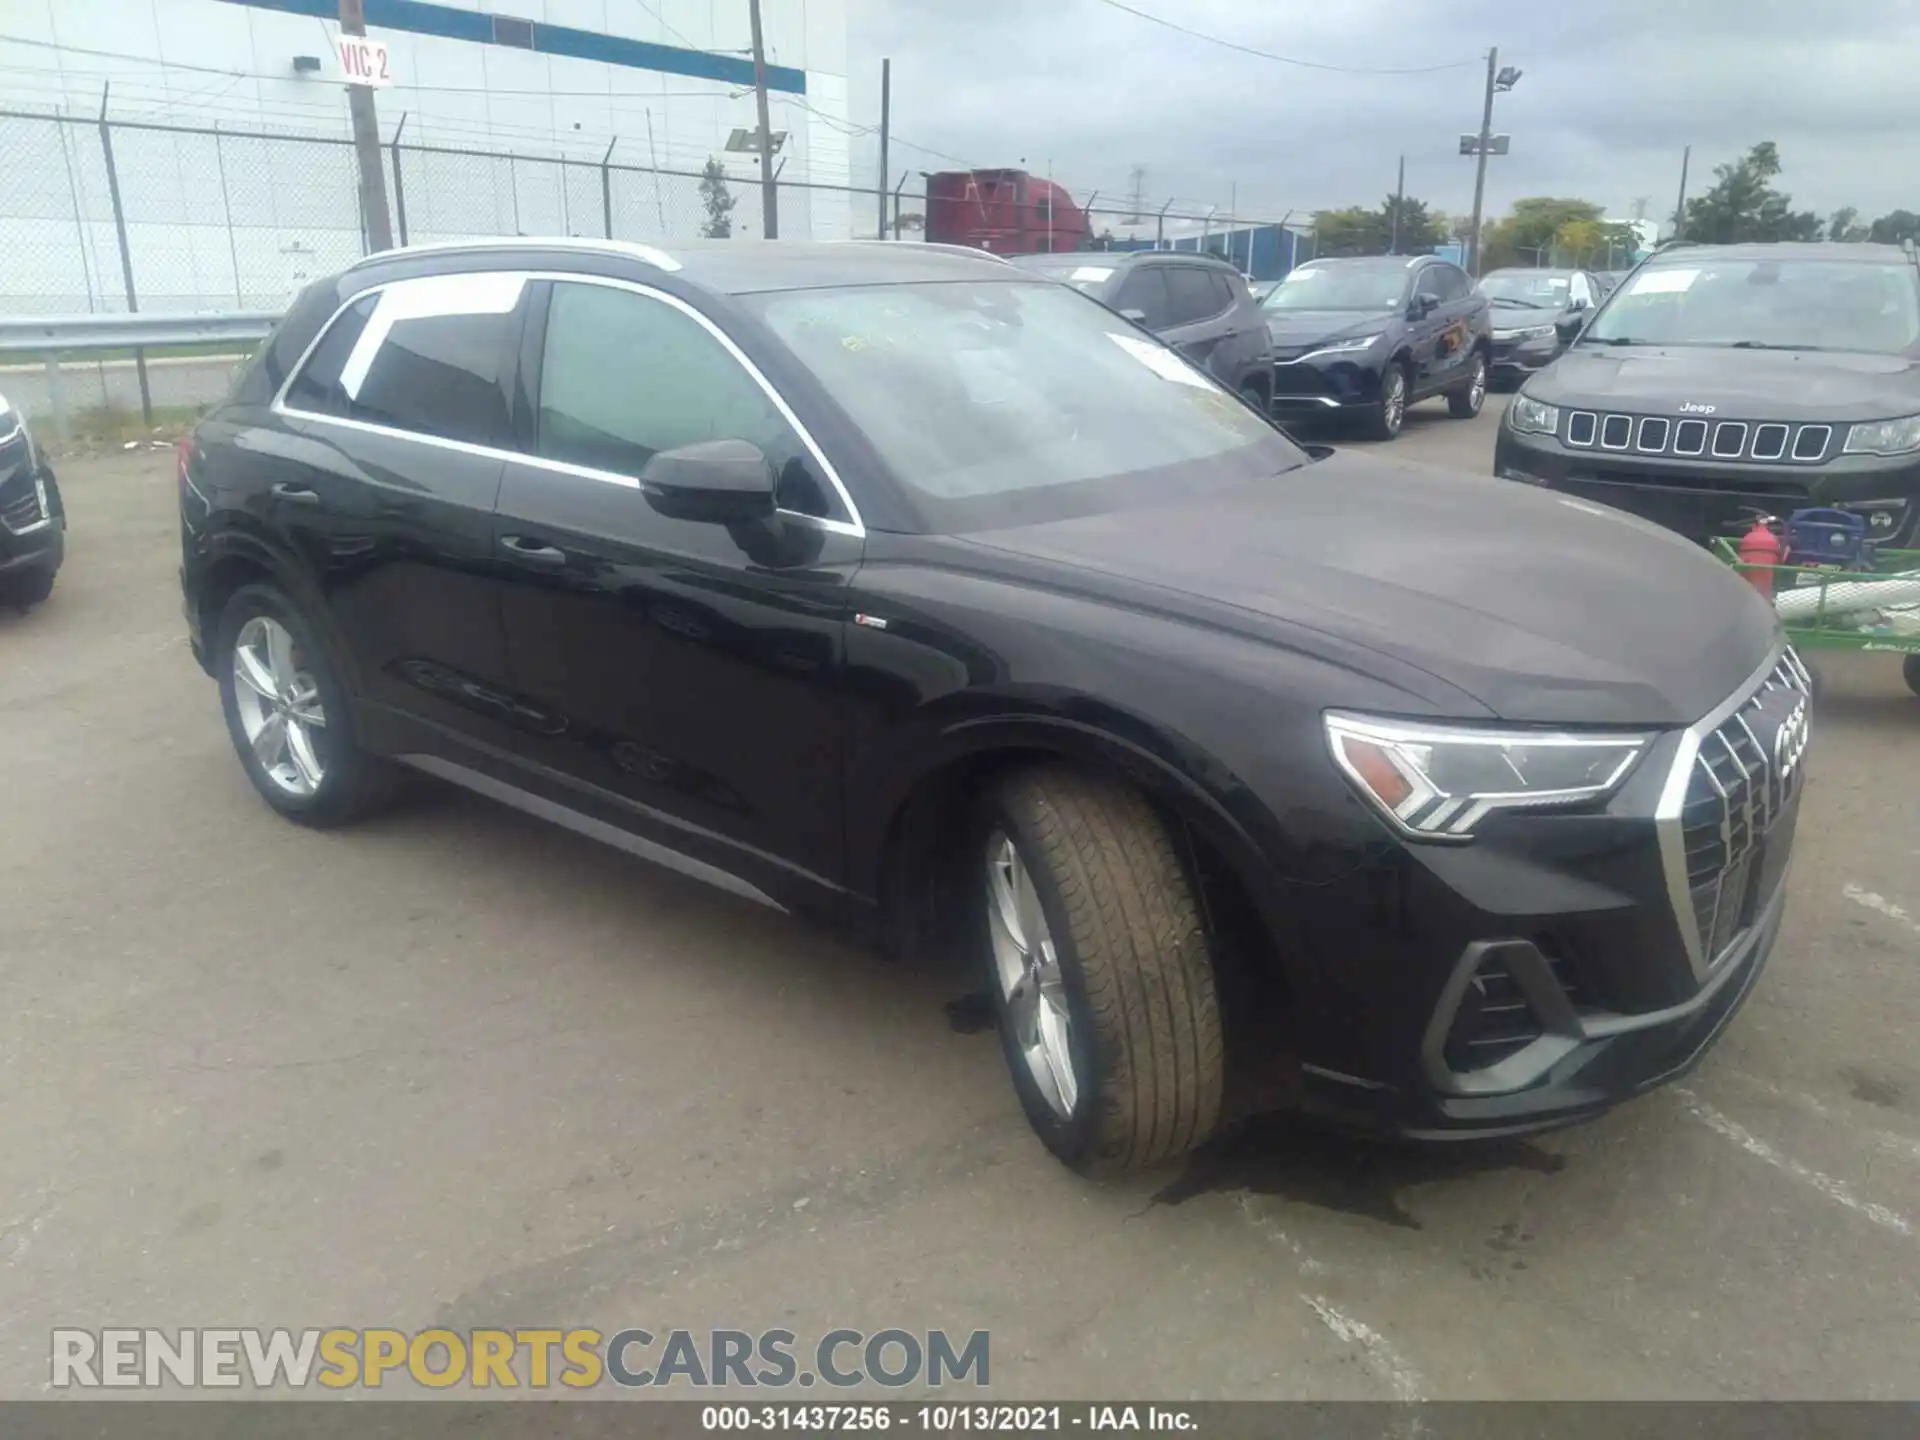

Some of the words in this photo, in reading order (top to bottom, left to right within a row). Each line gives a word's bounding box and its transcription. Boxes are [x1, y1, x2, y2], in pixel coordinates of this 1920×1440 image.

[339, 41, 373, 78] VIC
[376, 47, 390, 80] 2
[1679, 401, 1717, 415] Jeep
